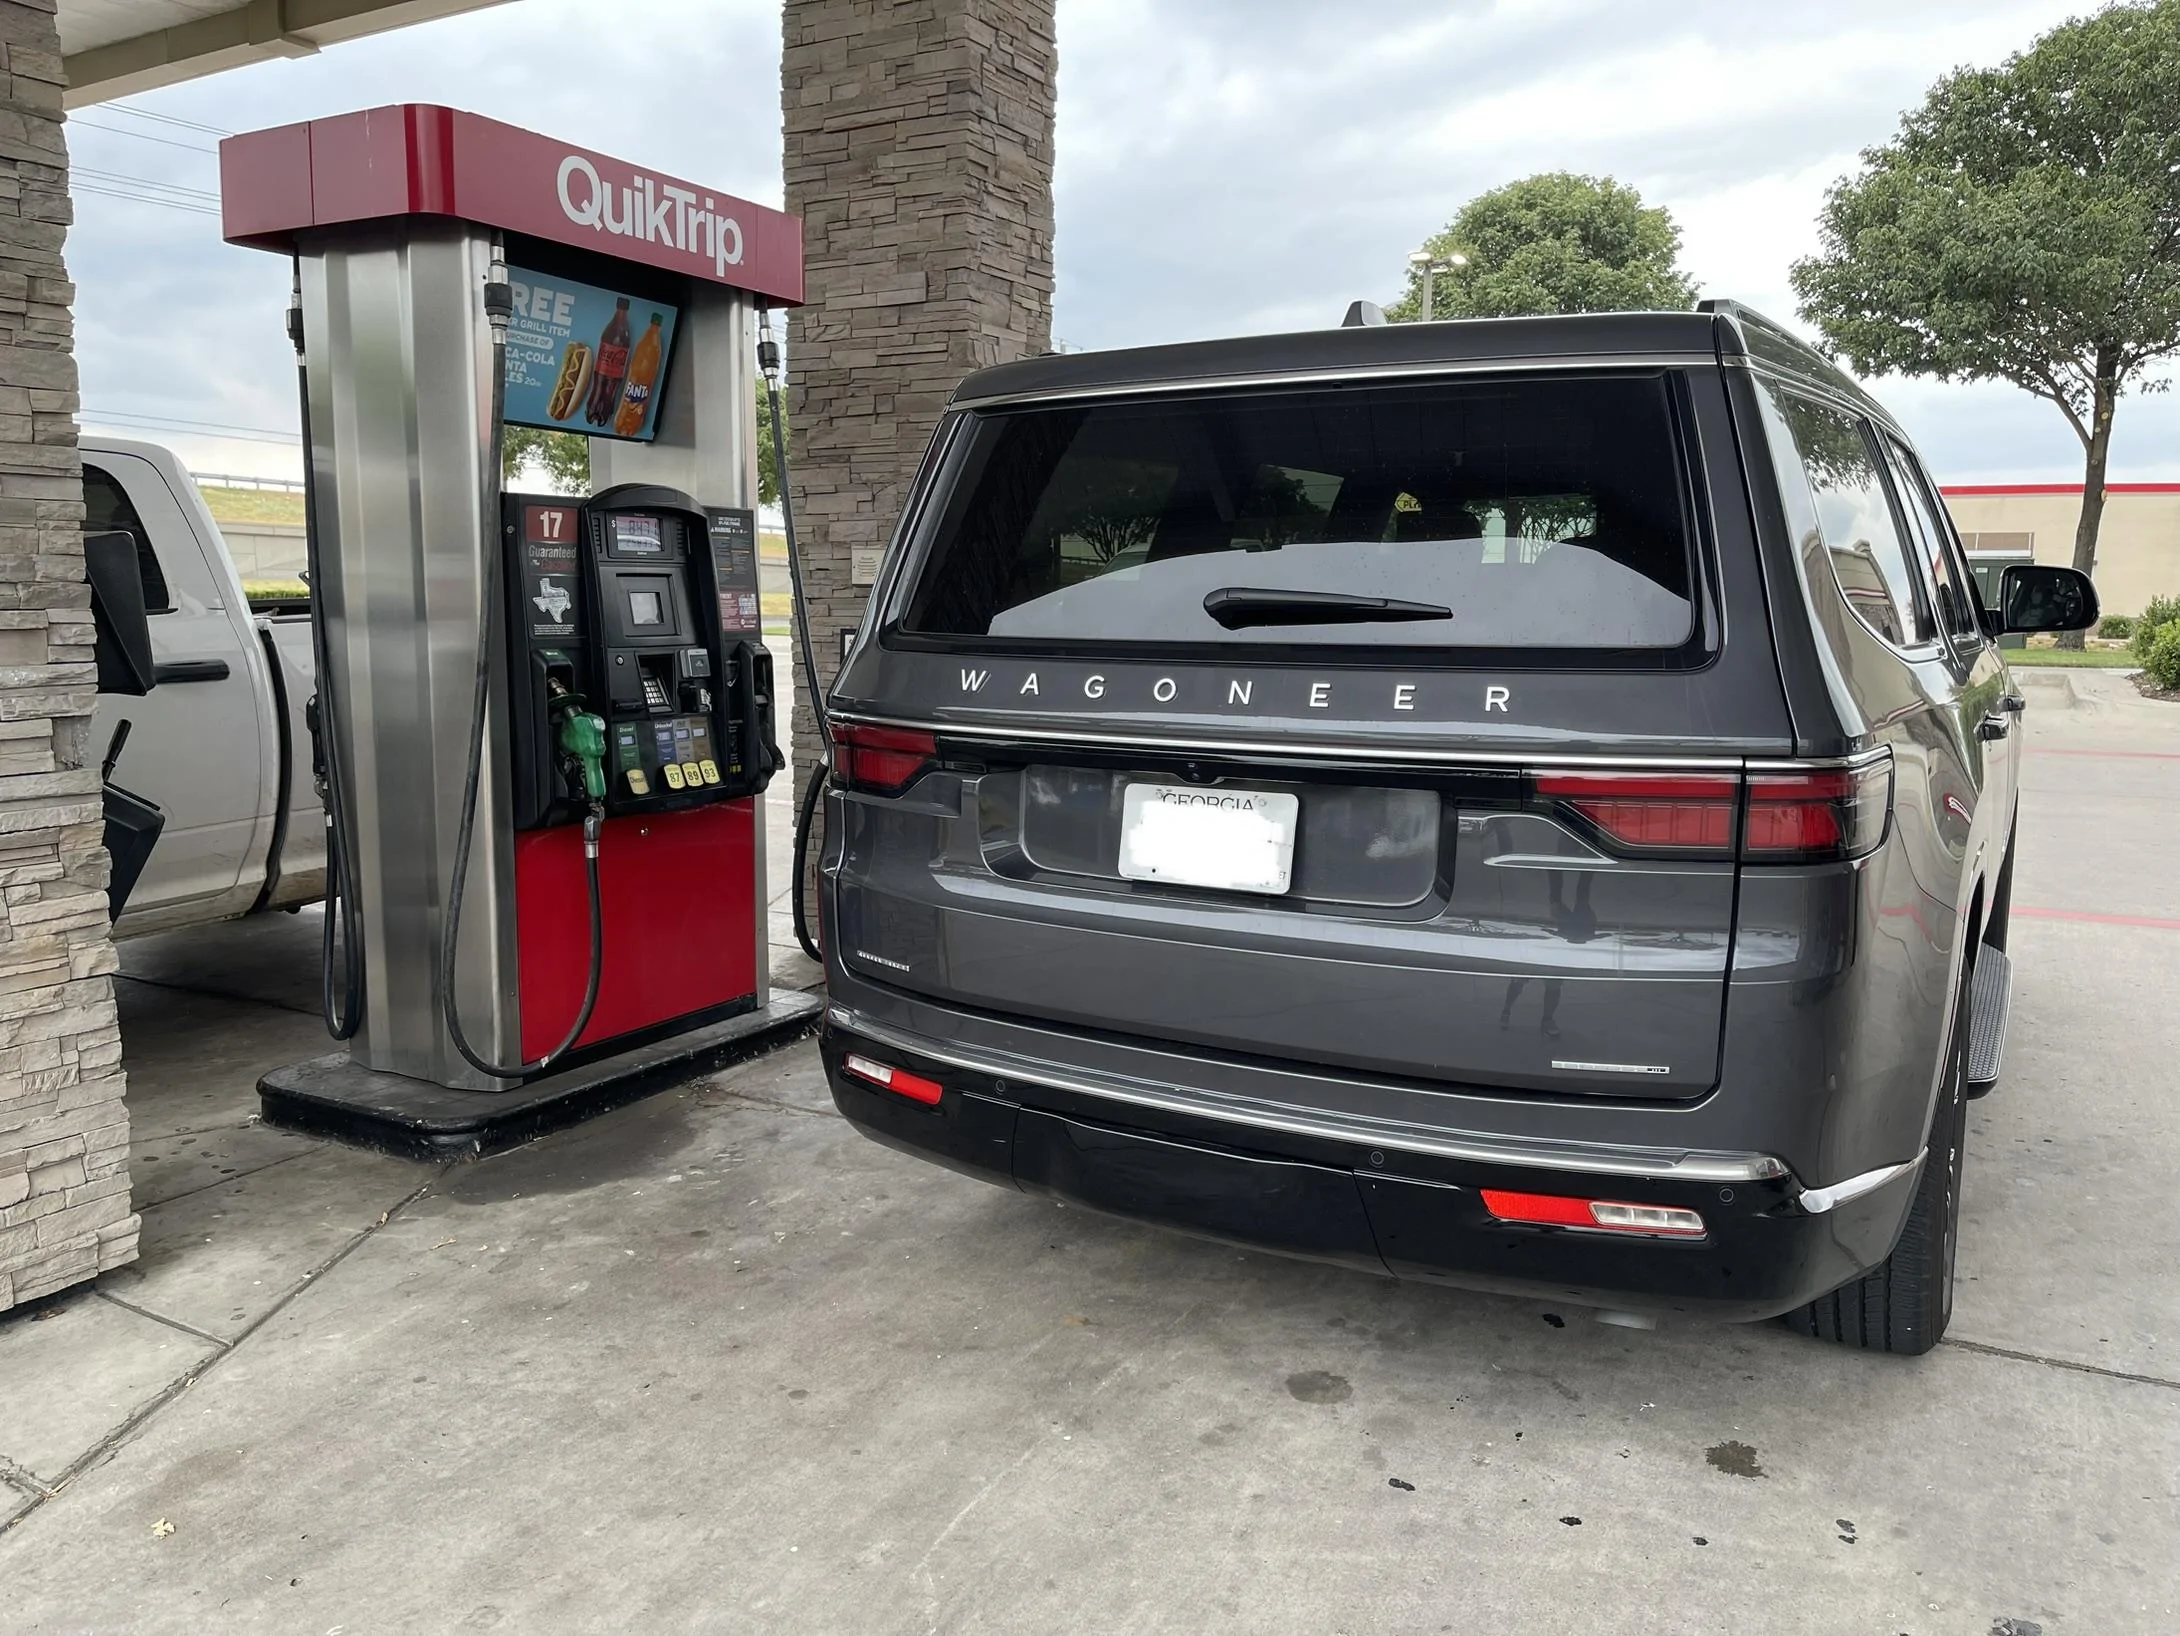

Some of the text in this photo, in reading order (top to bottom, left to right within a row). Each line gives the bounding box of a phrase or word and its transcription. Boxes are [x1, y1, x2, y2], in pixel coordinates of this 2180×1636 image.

[557, 155, 743, 277] QuikTrip
[510, 281, 575, 327] REE
[520, 319, 547, 333] GRILL
[549, 325, 571, 338] ITEM
[504, 346, 555, 366] CA-COLA
[505, 359, 527, 373] NTA
[540, 510, 563, 538] 17
[528, 544, 577, 559] Guaranteed
[960, 668, 1511, 713] WAGONEER
[669, 772, 680, 783] 87
[687, 771, 699, 782] 89
[704, 768, 716, 778] 93
